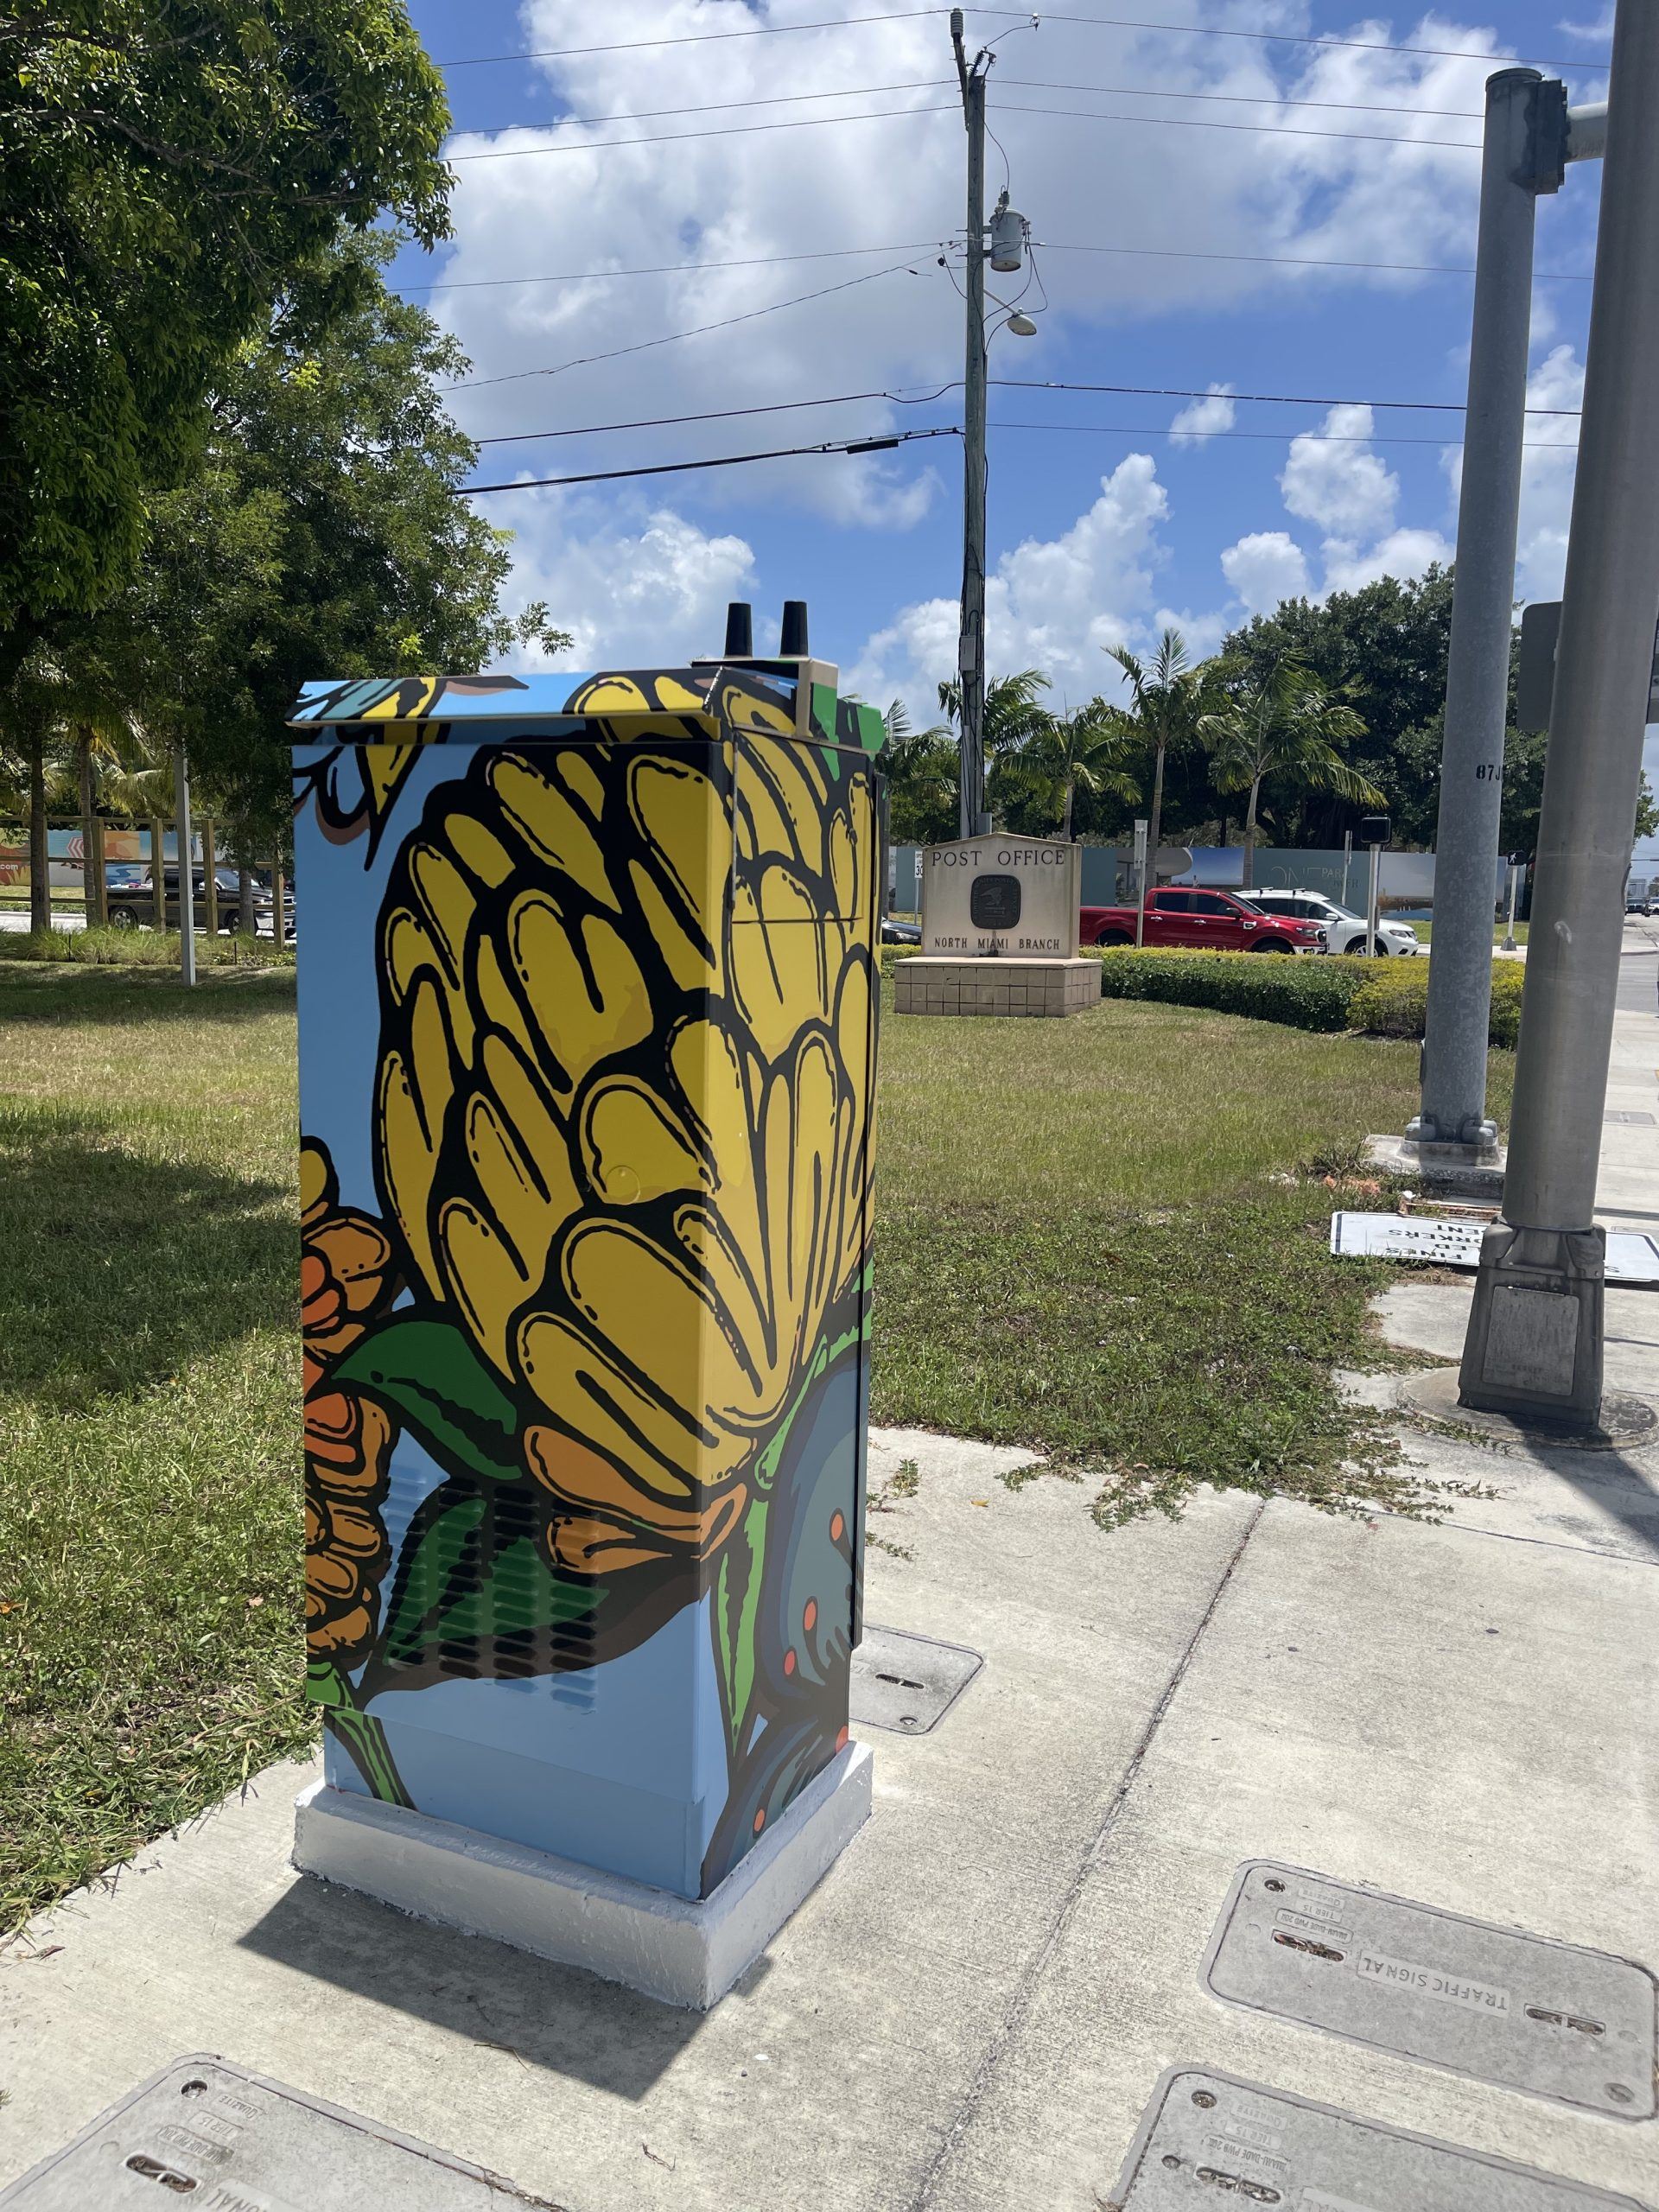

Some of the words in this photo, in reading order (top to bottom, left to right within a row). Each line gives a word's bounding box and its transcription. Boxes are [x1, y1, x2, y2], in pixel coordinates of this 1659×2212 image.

[932, 851, 982, 867] POST
[998, 849, 1065, 866] OFFICE
[934, 938, 968, 949] NORTH
[977, 938, 1008, 950] MIAMI
[1019, 938, 1059, 950] BRANCH
[1385, 1247, 1462, 1260] FINES
[1315, 1907, 1335, 1920] TIER
[1363, 1957, 1427, 1987] SIGNAL
[1432, 1978, 1507, 2011] TRAFFIC
[210, 2121, 234, 2137] TIER
[1249, 2130, 1272, 2145] TIER
